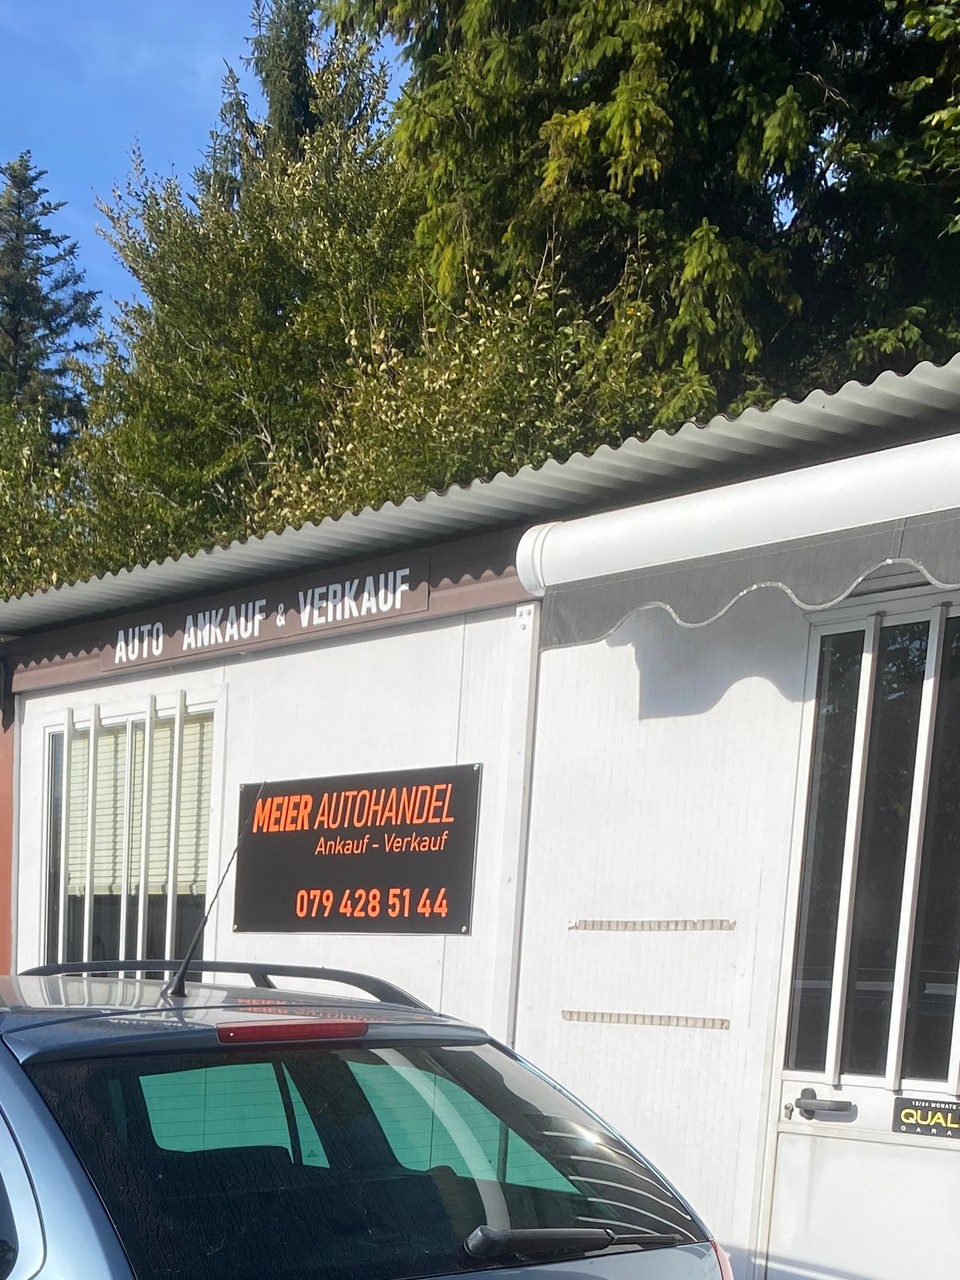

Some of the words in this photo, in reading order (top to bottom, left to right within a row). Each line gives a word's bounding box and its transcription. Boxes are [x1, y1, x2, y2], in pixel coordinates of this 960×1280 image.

[114, 621, 164, 664] AUTO
[182, 598, 267, 651] ANKAUF
[276, 602, 286, 628] &
[298, 567, 410, 628] VERKAUF
[252, 793, 314, 833] MEIER
[314, 783, 455, 830] AUTOHANDEL
[315, 834, 370, 856] Ankauf
[384, 830, 449, 853] Verkauf
[296, 889, 334, 918] 079
[339, 888, 381, 918] 428
[387, 888, 411, 918] 51
[417, 888, 448, 918] 44
[900, 1108, 960, 1129] QUAL
[931, 1102, 957, 1110] MONATE
